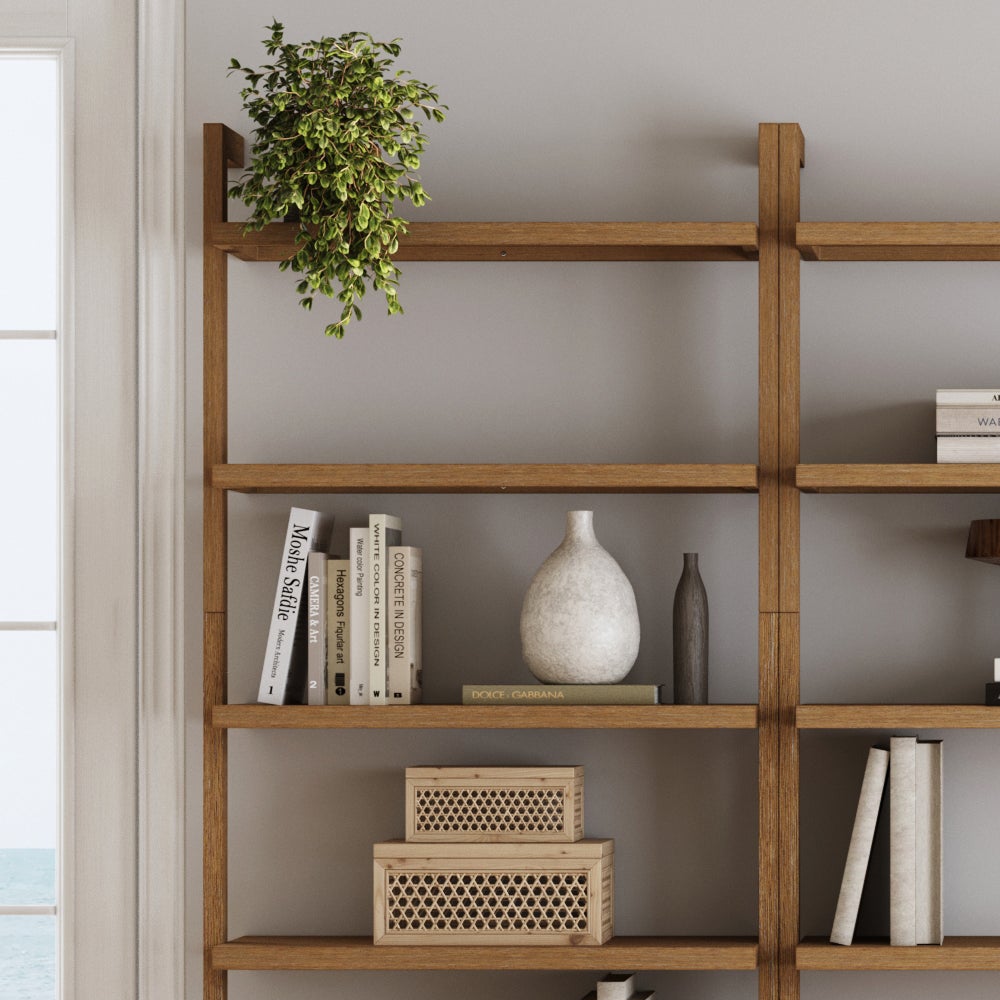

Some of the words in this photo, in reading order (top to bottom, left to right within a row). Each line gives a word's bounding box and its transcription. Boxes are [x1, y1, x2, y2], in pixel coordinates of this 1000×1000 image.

[285, 523, 310, 573] Moshe
[393, 552, 405, 606] CONCRETE
[277, 577, 300, 622] Safdie
[309, 575, 320, 617] CAMERA
[335, 569, 347, 617] Hexagons
[373, 608, 380, 619] IN
[393, 609, 405, 619] IN
[309, 628, 320, 644] Art
[393, 623, 405, 659] DESIGN
[336, 652, 346, 664] art
[267, 685, 274, 695] 1
[309, 680, 318, 689] 2
[373, 690, 380, 698] W
[471, 690, 506, 699] DOLCE
[511, 690, 565, 699] GABBANA
